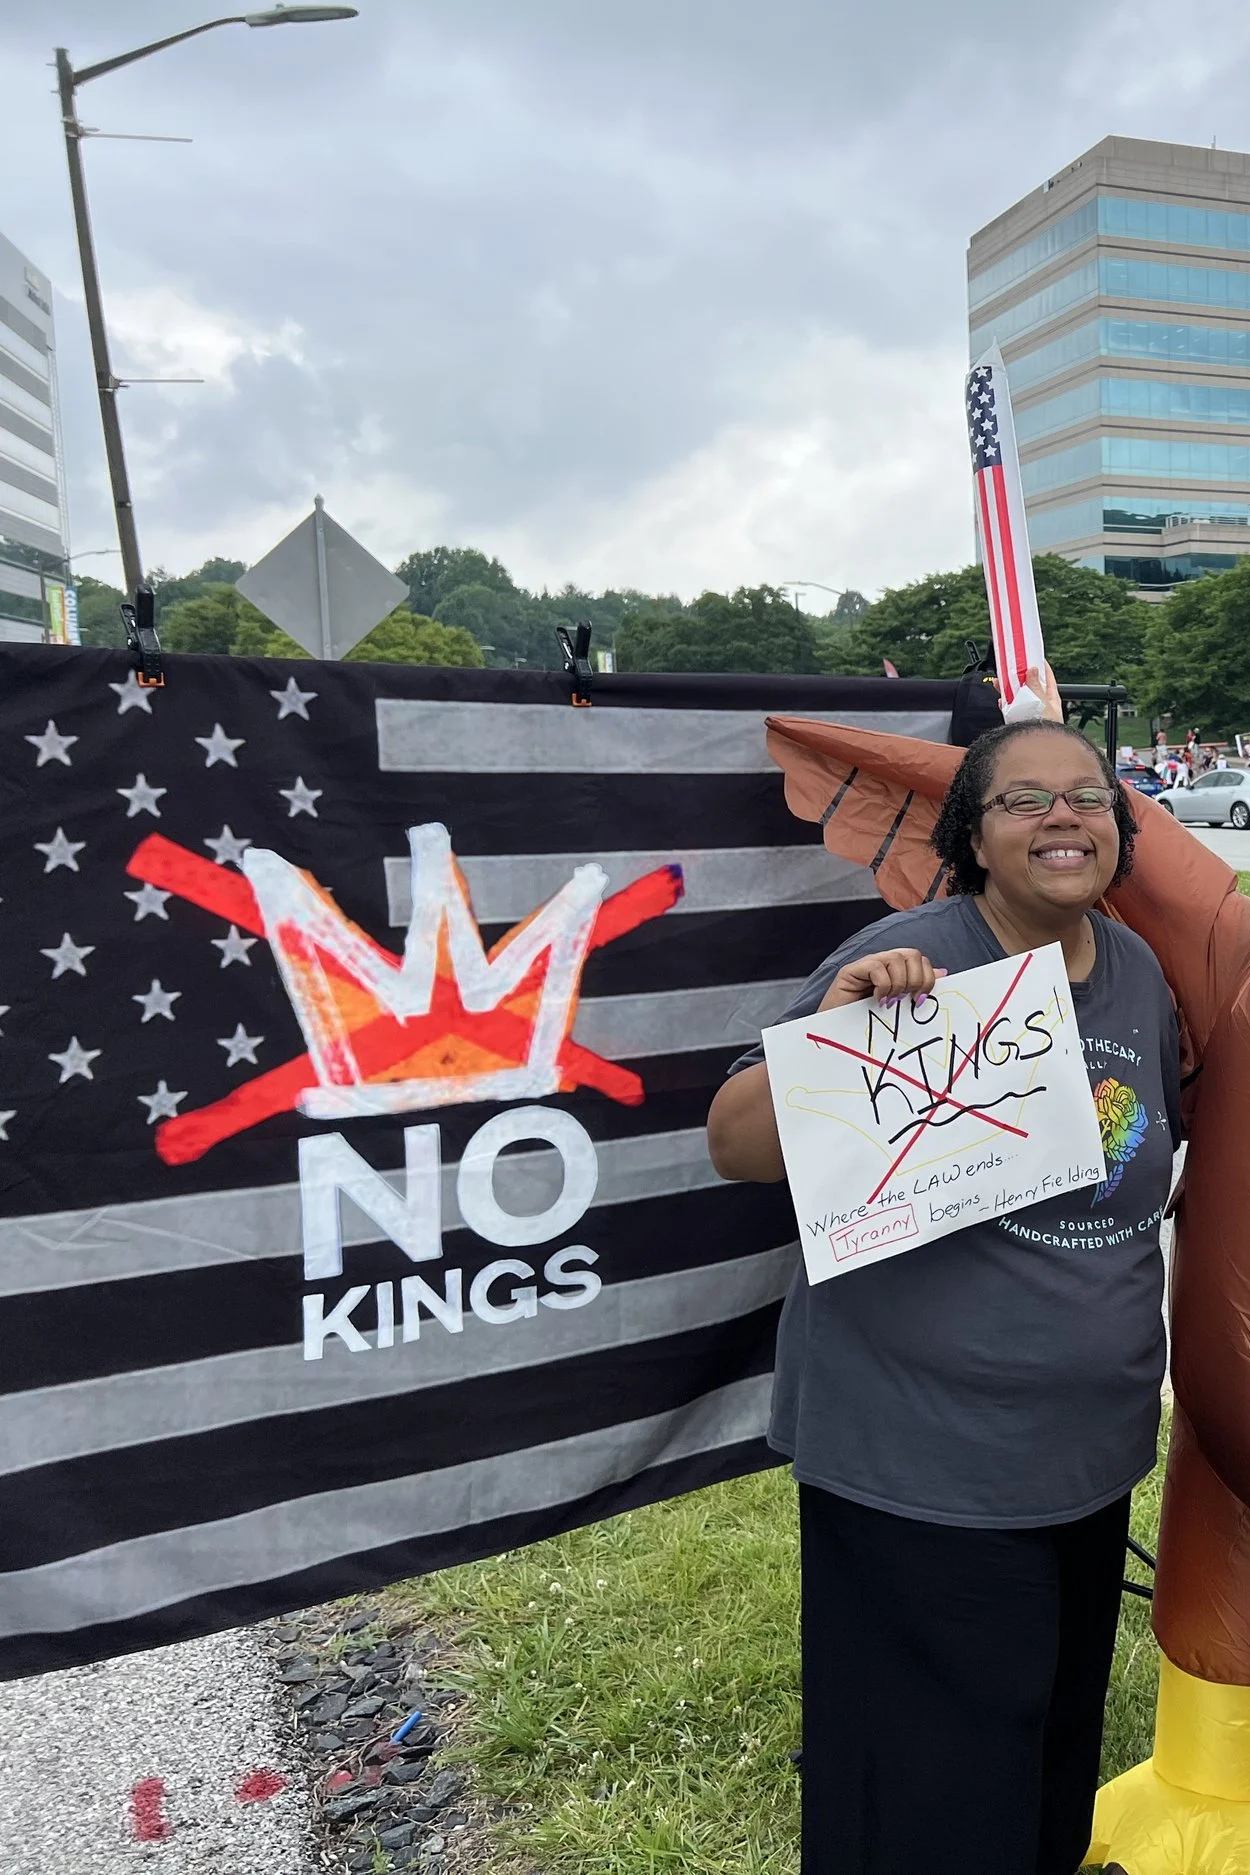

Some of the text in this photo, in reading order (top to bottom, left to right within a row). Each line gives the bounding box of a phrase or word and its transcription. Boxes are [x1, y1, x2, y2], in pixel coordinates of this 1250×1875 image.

[868, 995, 939, 1053] NO
[297, 1104, 599, 1281] NO
[806, 1203, 869, 1238] Where
[878, 1190, 906, 1208] the
[914, 1165, 960, 1195] LAW
[836, 1214, 912, 1254] Tyranny
[929, 1194, 981, 1223] begins
[998, 1216, 1103, 1250] HANDCRAFTED
[1105, 1226, 1134, 1247] WITH
[1059, 1217, 1115, 1231] SOURCED
[302, 1244, 603, 1361] KINGS
